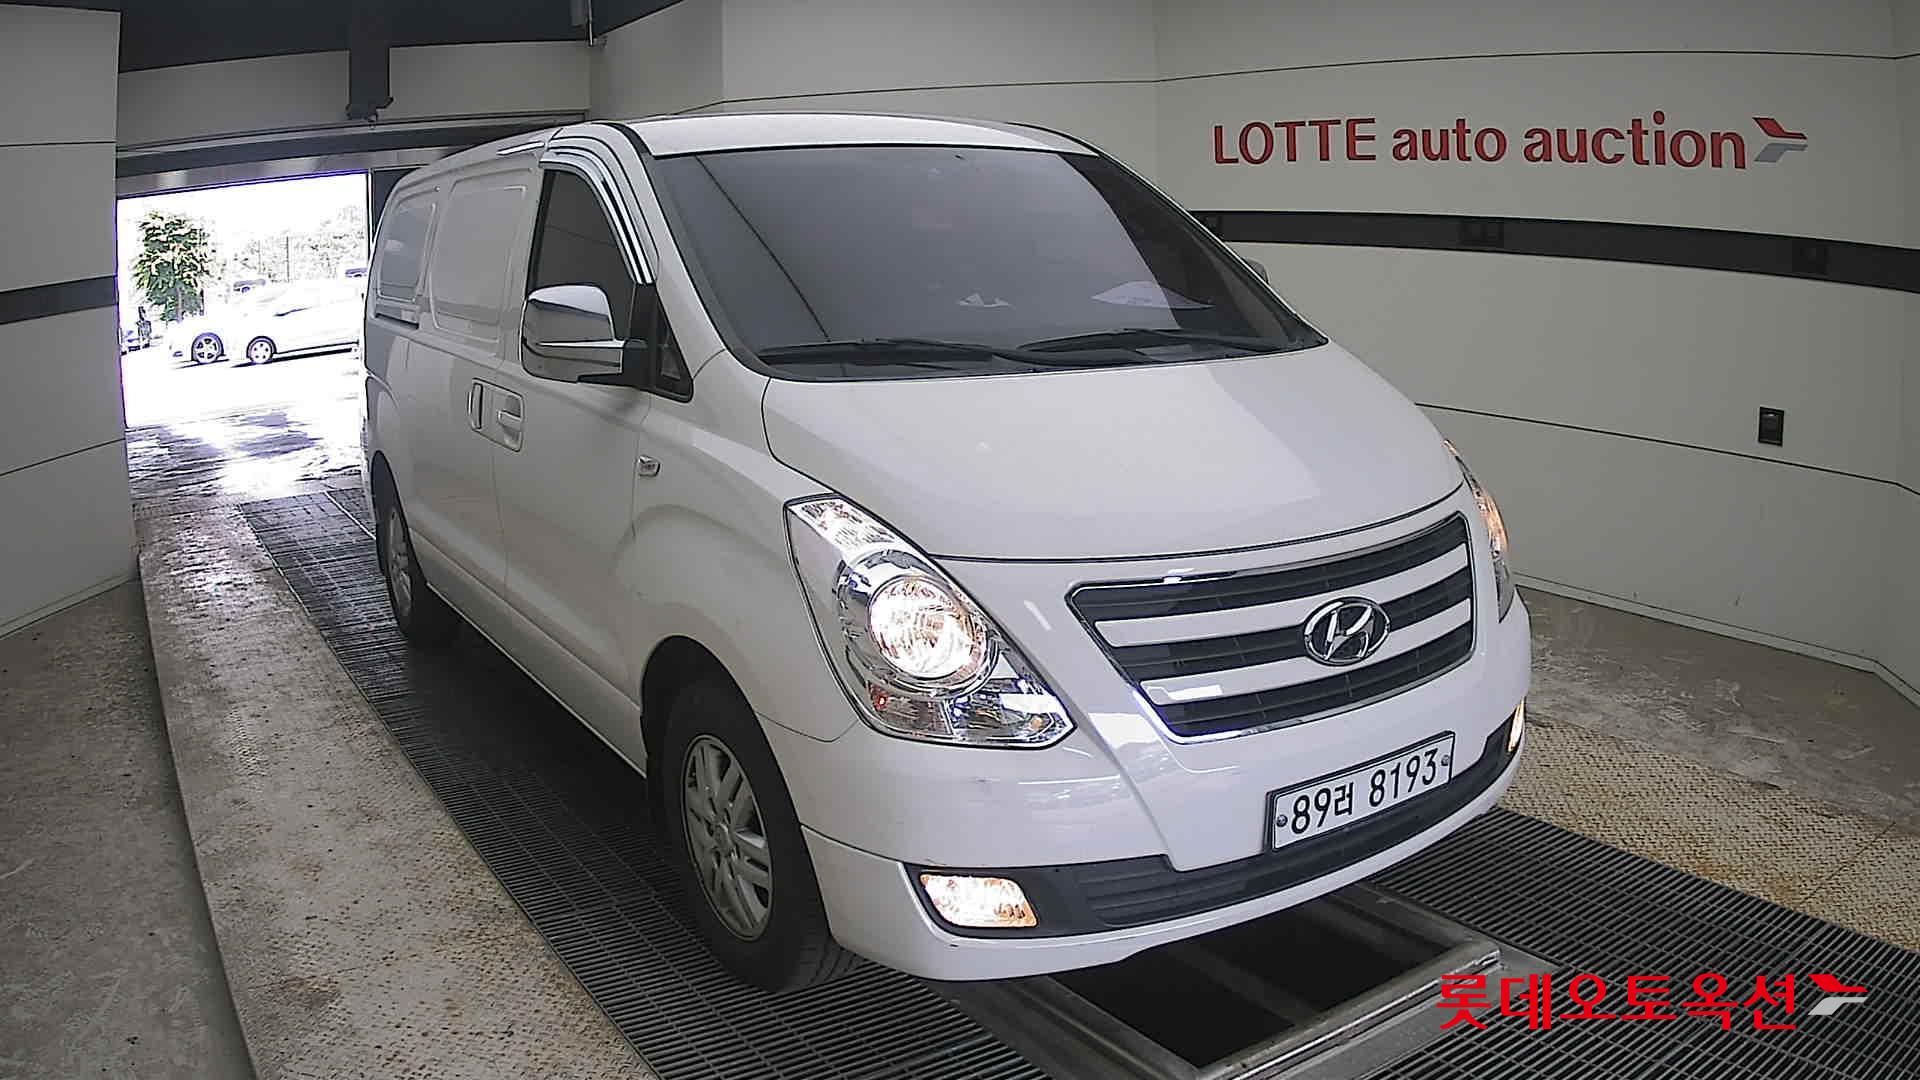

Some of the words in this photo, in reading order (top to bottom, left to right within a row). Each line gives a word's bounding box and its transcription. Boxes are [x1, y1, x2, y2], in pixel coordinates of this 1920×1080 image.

[1214, 117, 1376, 164] LOTTE
[1392, 119, 1507, 162] auto
[1523, 111, 1746, 169] auction
[1291, 781, 1354, 835] 89러
[1368, 747, 1439, 808] 8193
